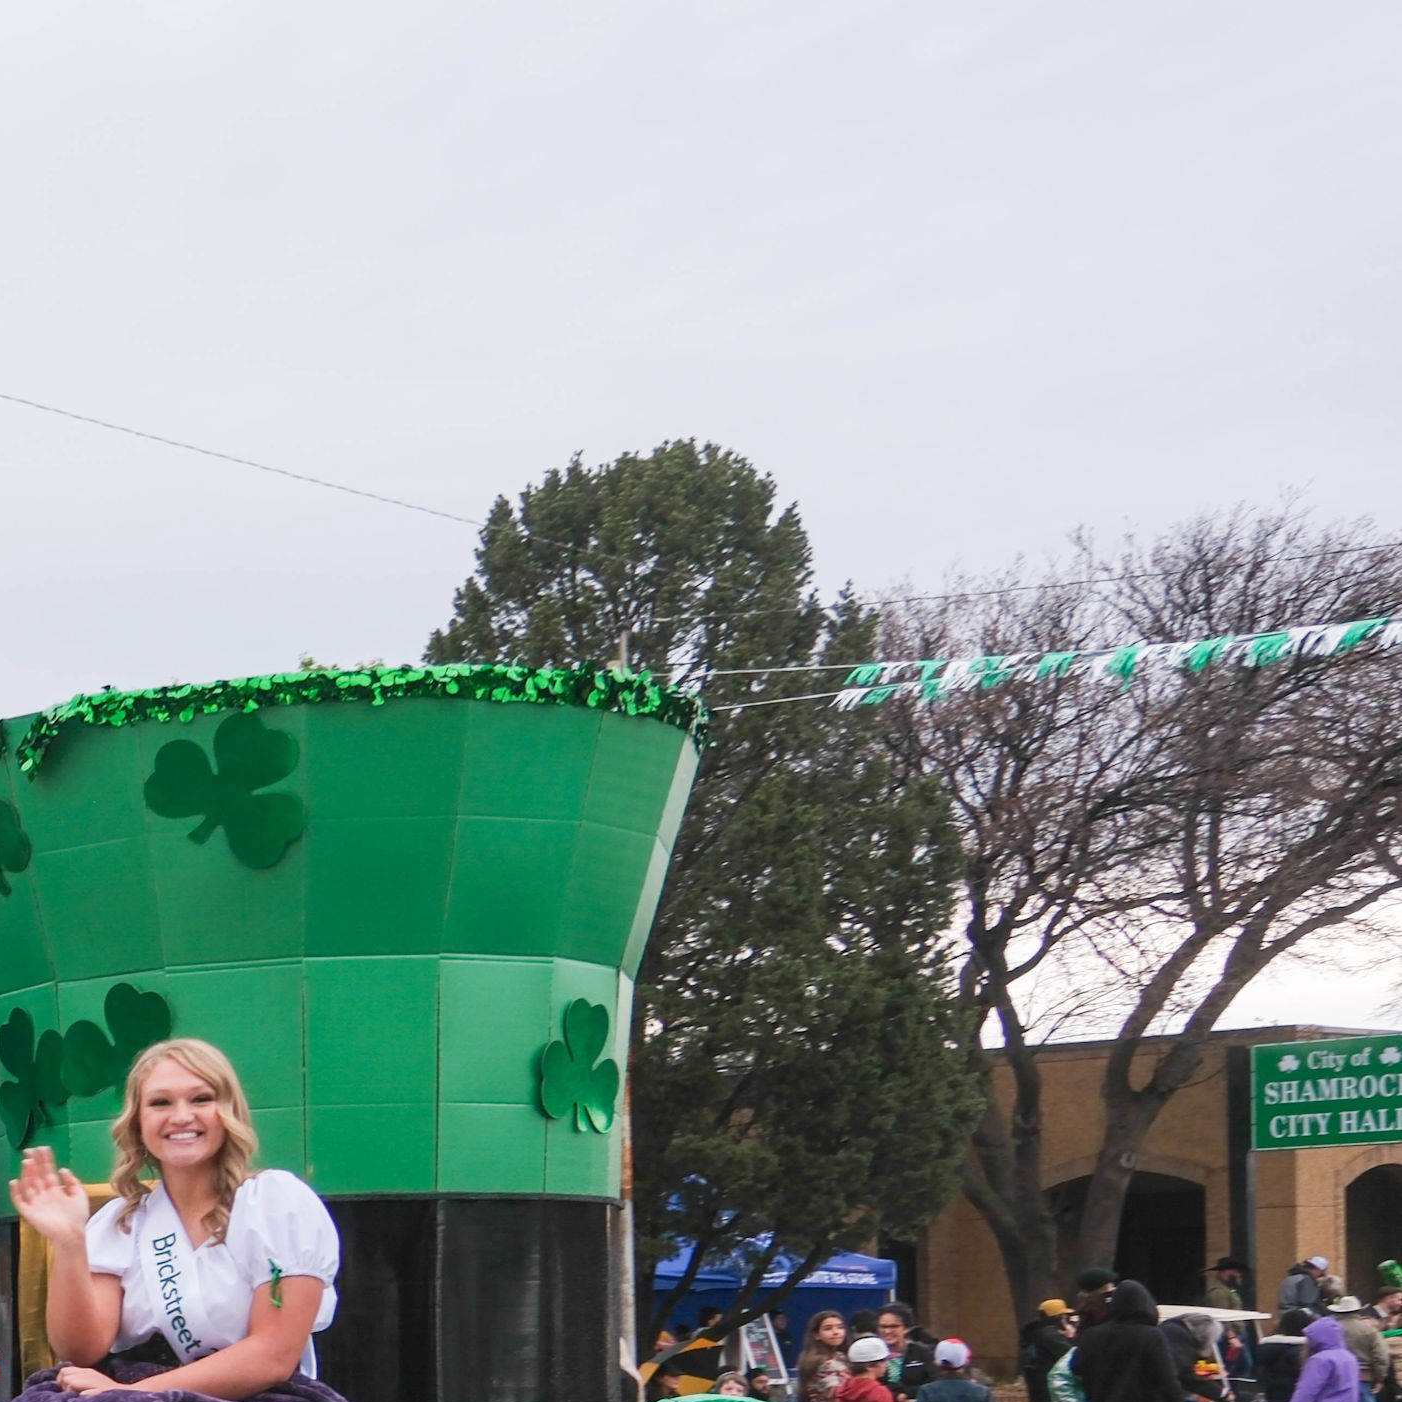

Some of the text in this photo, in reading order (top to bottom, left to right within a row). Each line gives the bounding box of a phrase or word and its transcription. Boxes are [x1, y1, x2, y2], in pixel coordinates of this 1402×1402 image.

[1306, 1047, 1373, 1072] City of
[1269, 1112, 1333, 1139] CITY
[152, 1232, 202, 1354] Brickstreet
